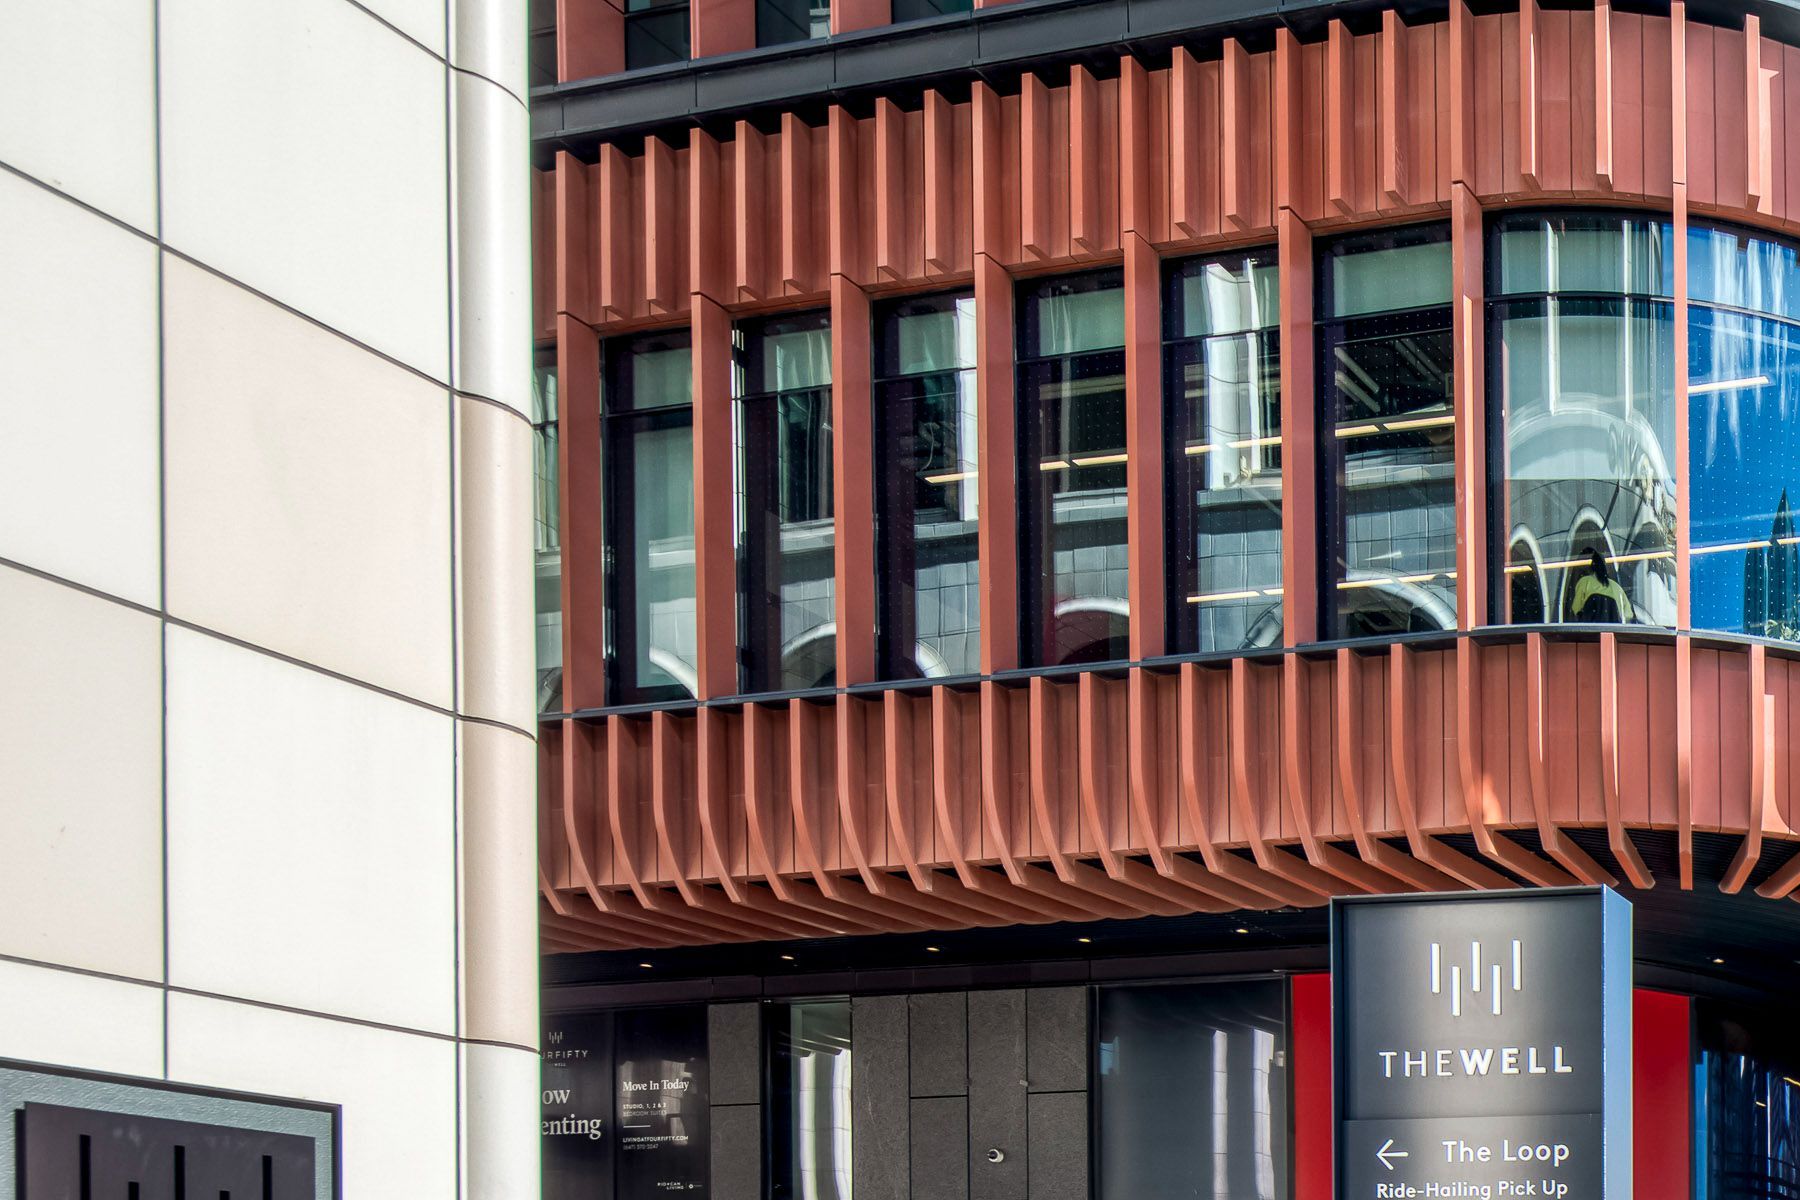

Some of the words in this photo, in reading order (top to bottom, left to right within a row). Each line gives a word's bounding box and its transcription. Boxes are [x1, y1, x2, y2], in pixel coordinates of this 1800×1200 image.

[541, 1050, 588, 1060] URFIFTY
[623, 1081, 647, 1092] Move
[650, 1081, 660, 1090] In
[661, 1079, 690, 1092] Today
[542, 1089, 570, 1105] ow
[541, 1113, 602, 1140] enting
[1442, 1140, 1492, 1163] The
[1503, 1139, 1570, 1167] Loop
[1376, 1182, 1491, 1200] Ride-Hailing
[1498, 1180, 1537, 1197] Pick
[1542, 1180, 1569, 1199] Up
